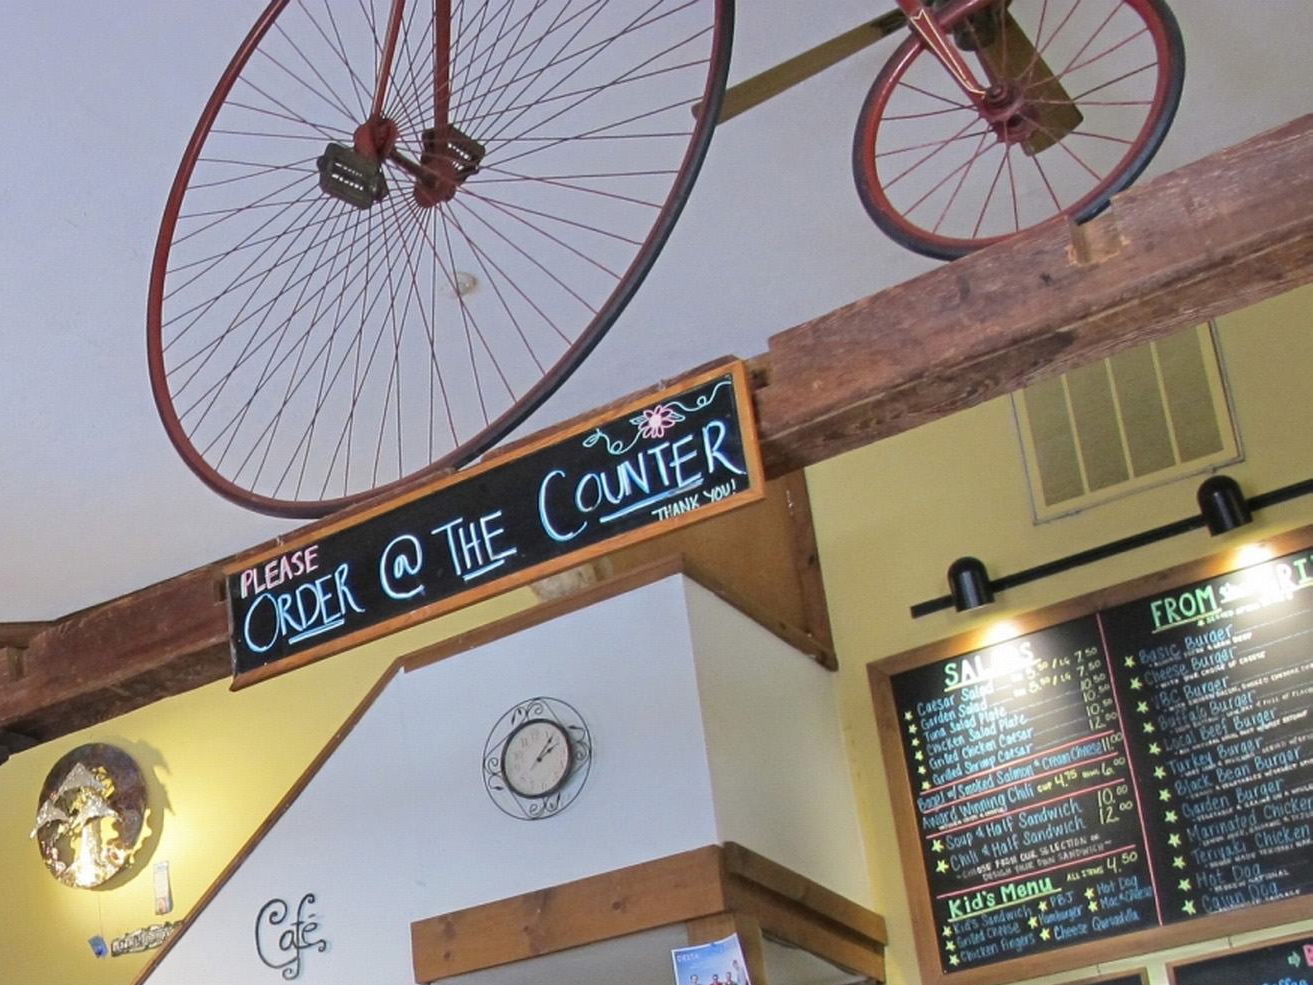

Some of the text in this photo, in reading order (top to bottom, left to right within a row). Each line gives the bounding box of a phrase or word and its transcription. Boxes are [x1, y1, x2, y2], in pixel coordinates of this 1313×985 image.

[652, 479, 737, 521] THANK YOU!
[244, 421, 746, 651] ORDER @ THE COUNTER
[240, 544, 319, 598] PLEASE
[1151, 586, 1216, 627] FROM
[946, 644, 1031, 684] SALS
[1138, 624, 1232, 664] Basic Burger
[1144, 646, 1236, 685] Cheese Burger
[917, 695, 954, 716] Caesar
[961, 685, 993, 701] Salad
[921, 710, 956, 729] Garden
[958, 696, 987, 717] Salad
[1076, 660, 1101, 677] 7.50
[1183, 676, 1230, 701] Burger
[924, 727, 946, 741] Tuna
[950, 715, 976, 733] Salad
[978, 706, 1007, 724] Plate
[1158, 705, 1207, 730] Buffalo
[1209, 690, 1255, 715] Burger
[1163, 730, 1196, 751] Local
[1199, 718, 1229, 740] Beef
[1233, 710, 1280, 735] Burger
[926, 735, 965, 756] Chicken
[968, 723, 996, 742] Salad
[998, 714, 1028, 732] Plate
[929, 750, 959, 769] Grilled
[962, 740, 996, 758] Chicken
[998, 728, 1033, 747] Caesar
[932, 712, 1117, 784] Grilled Shrimp Caesar 12.00
[1168, 752, 1214, 774] Turkey
[1216, 736, 1264, 759] Burger
[957, 774, 994, 798] Smoked
[995, 765, 1034, 784] Salmon
[1041, 752, 1070, 770] Cream
[1174, 774, 1212, 795] Black
[1216, 764, 1250, 782] Bean
[1254, 746, 1300, 770] Burger
[922, 807, 958, 828] Award
[959, 794, 1007, 820] Winning
[1007, 783, 1034, 803] Chili
[1054, 769, 1077, 787] 4.75
[946, 832, 973, 850] Soup
[984, 814, 1012, 837] Half
[1017, 798, 1082, 828] Sandwich
[1097, 784, 1128, 808] 10.00
[1182, 796, 1230, 817] Garden
[1236, 778, 1283, 803] Burger
[950, 850, 978, 871] Chili
[991, 834, 1018, 857] Half
[1023, 815, 1086, 845] Sandwich
[1099, 800, 1133, 824] 12.00
[1186, 809, 1256, 841] Marinated
[1192, 839, 1247, 864] Teriyaki
[1254, 824, 1310, 848] Chicken
[1039, 837, 1086, 855] SELECTION
[948, 891, 997, 918] Kid's
[1000, 878, 1053, 902] Menu
[1066, 872, 1080, 881] ALL
[1106, 851, 1138, 873] 4.50
[1196, 863, 1262, 888] Hot Dog
[1202, 887, 1244, 912] Cajun
[1248, 876, 1278, 899] Dog
[953, 918, 979, 934] Kid's
[981, 905, 1032, 925] Sandwich
[1096, 880, 1115, 894] Hot
[1118, 875, 1138, 890] Dog
[255, 893, 327, 980] Café
[960, 943, 998, 961] Chicken
[1000, 932, 1035, 951] Fingers
[1053, 924, 1087, 940] Cheese
